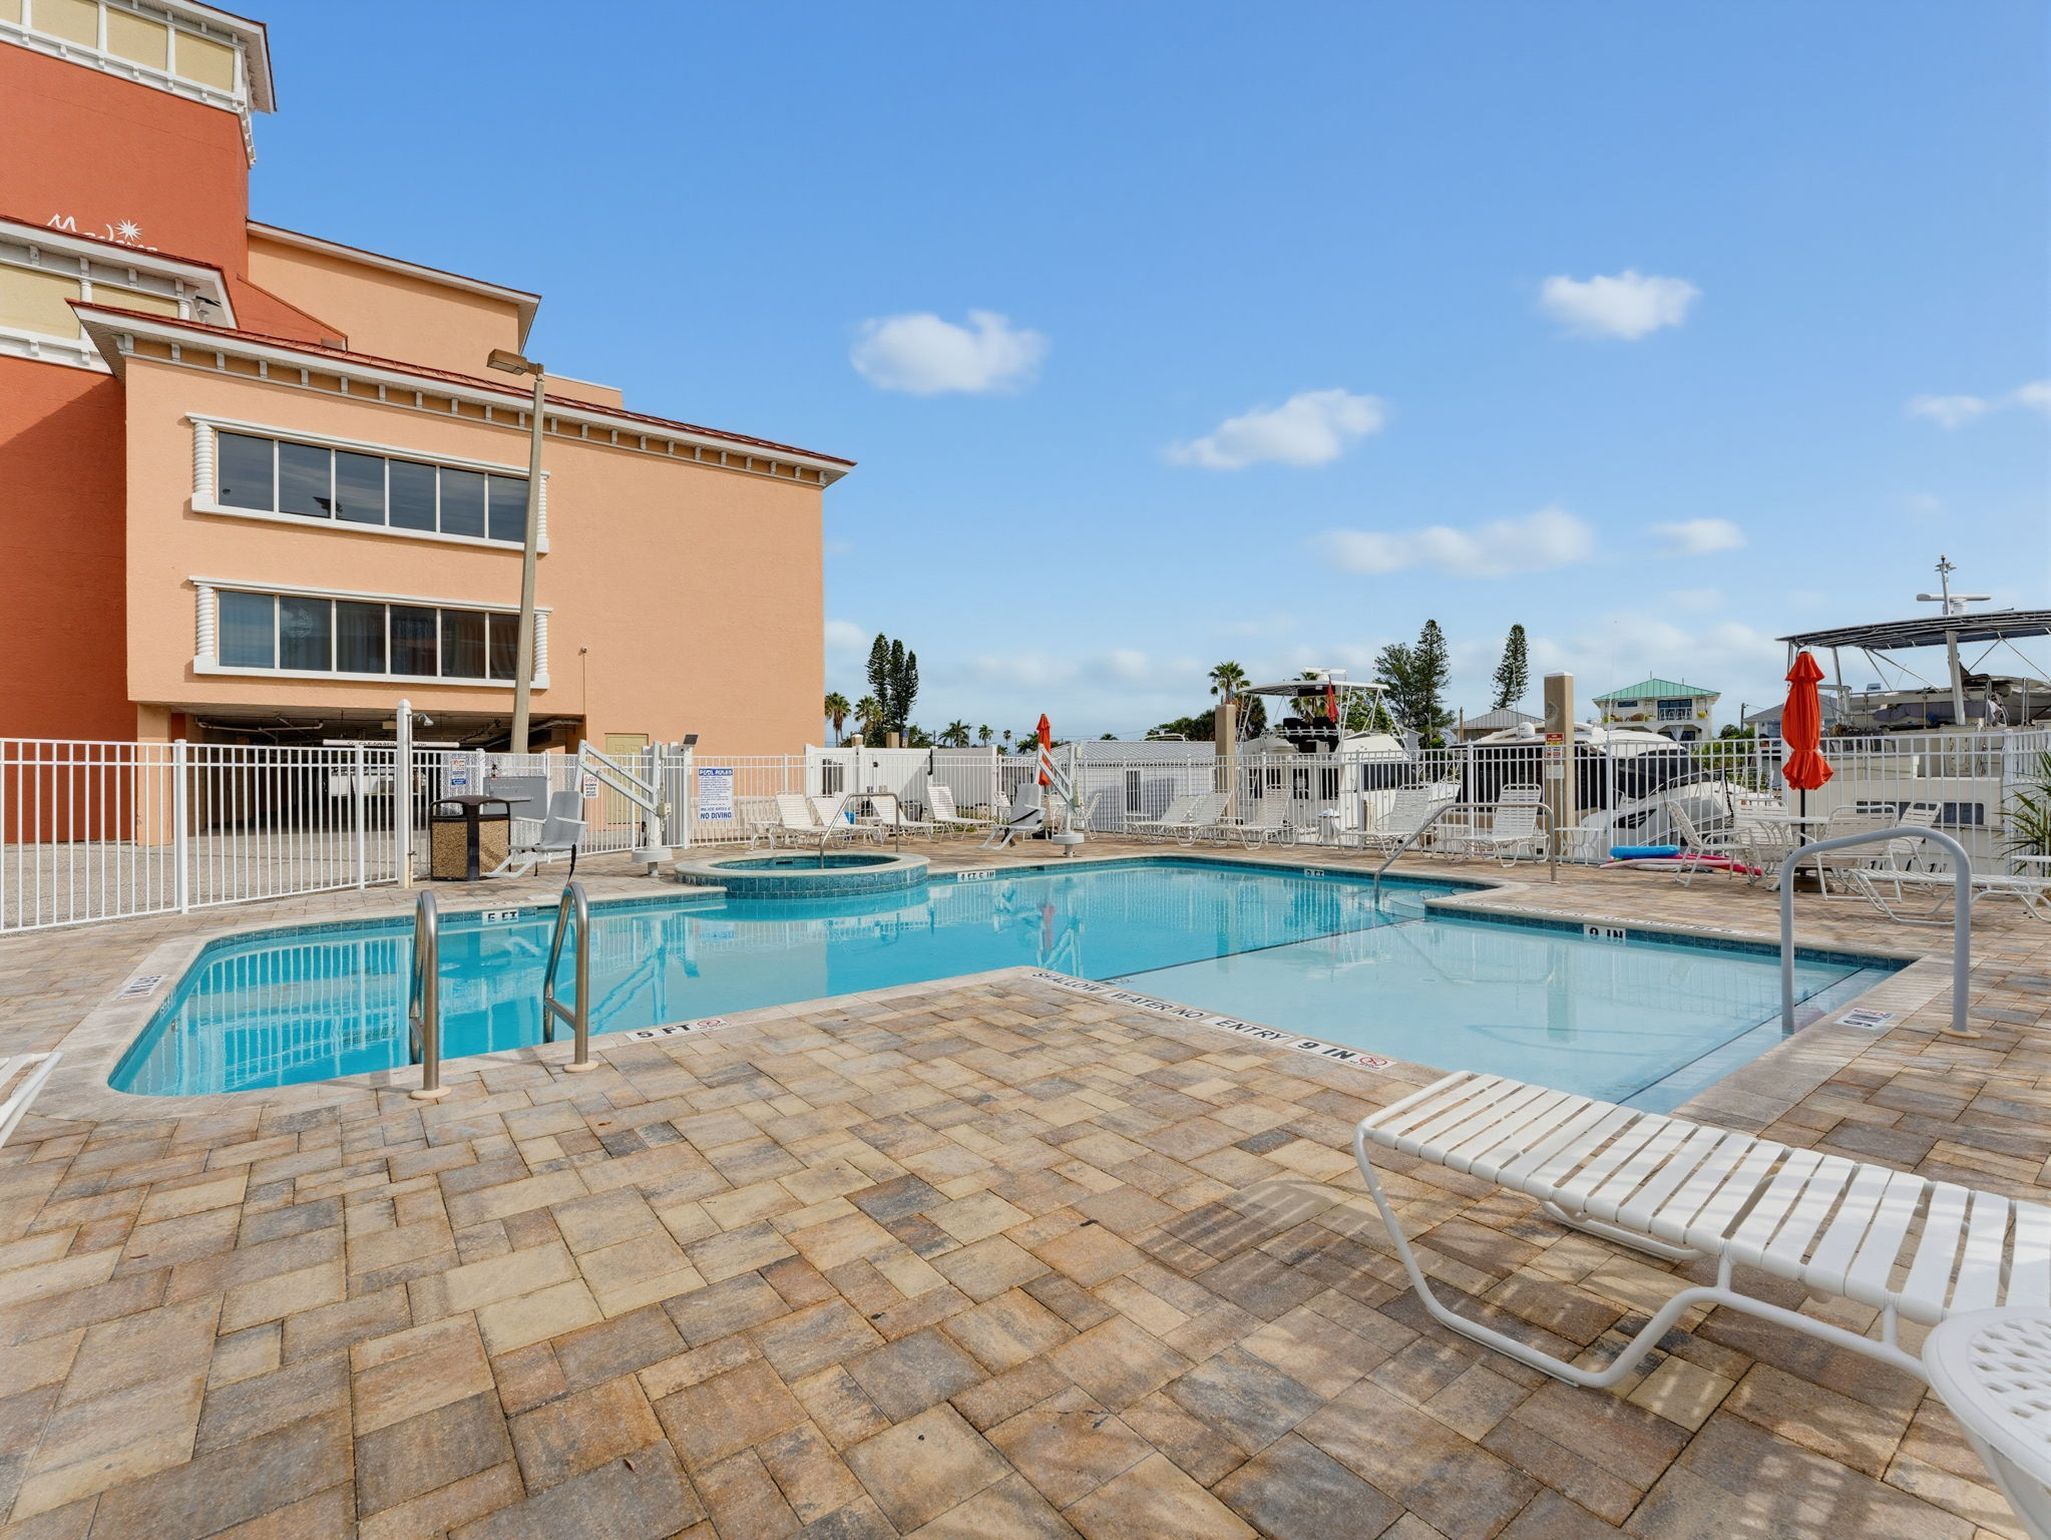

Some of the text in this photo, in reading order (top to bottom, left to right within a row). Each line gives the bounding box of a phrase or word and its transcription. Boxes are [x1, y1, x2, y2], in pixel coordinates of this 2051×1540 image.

[1111, 992, 1173, 1011] WATER
[1172, 1007, 1204, 1019] NO
[1215, 1019, 1290, 1041] ENTRY
[636, 1030, 654, 1038] 5
[661, 1023, 691, 1034] FT
[1297, 1041, 1358, 1060] 9 IN
